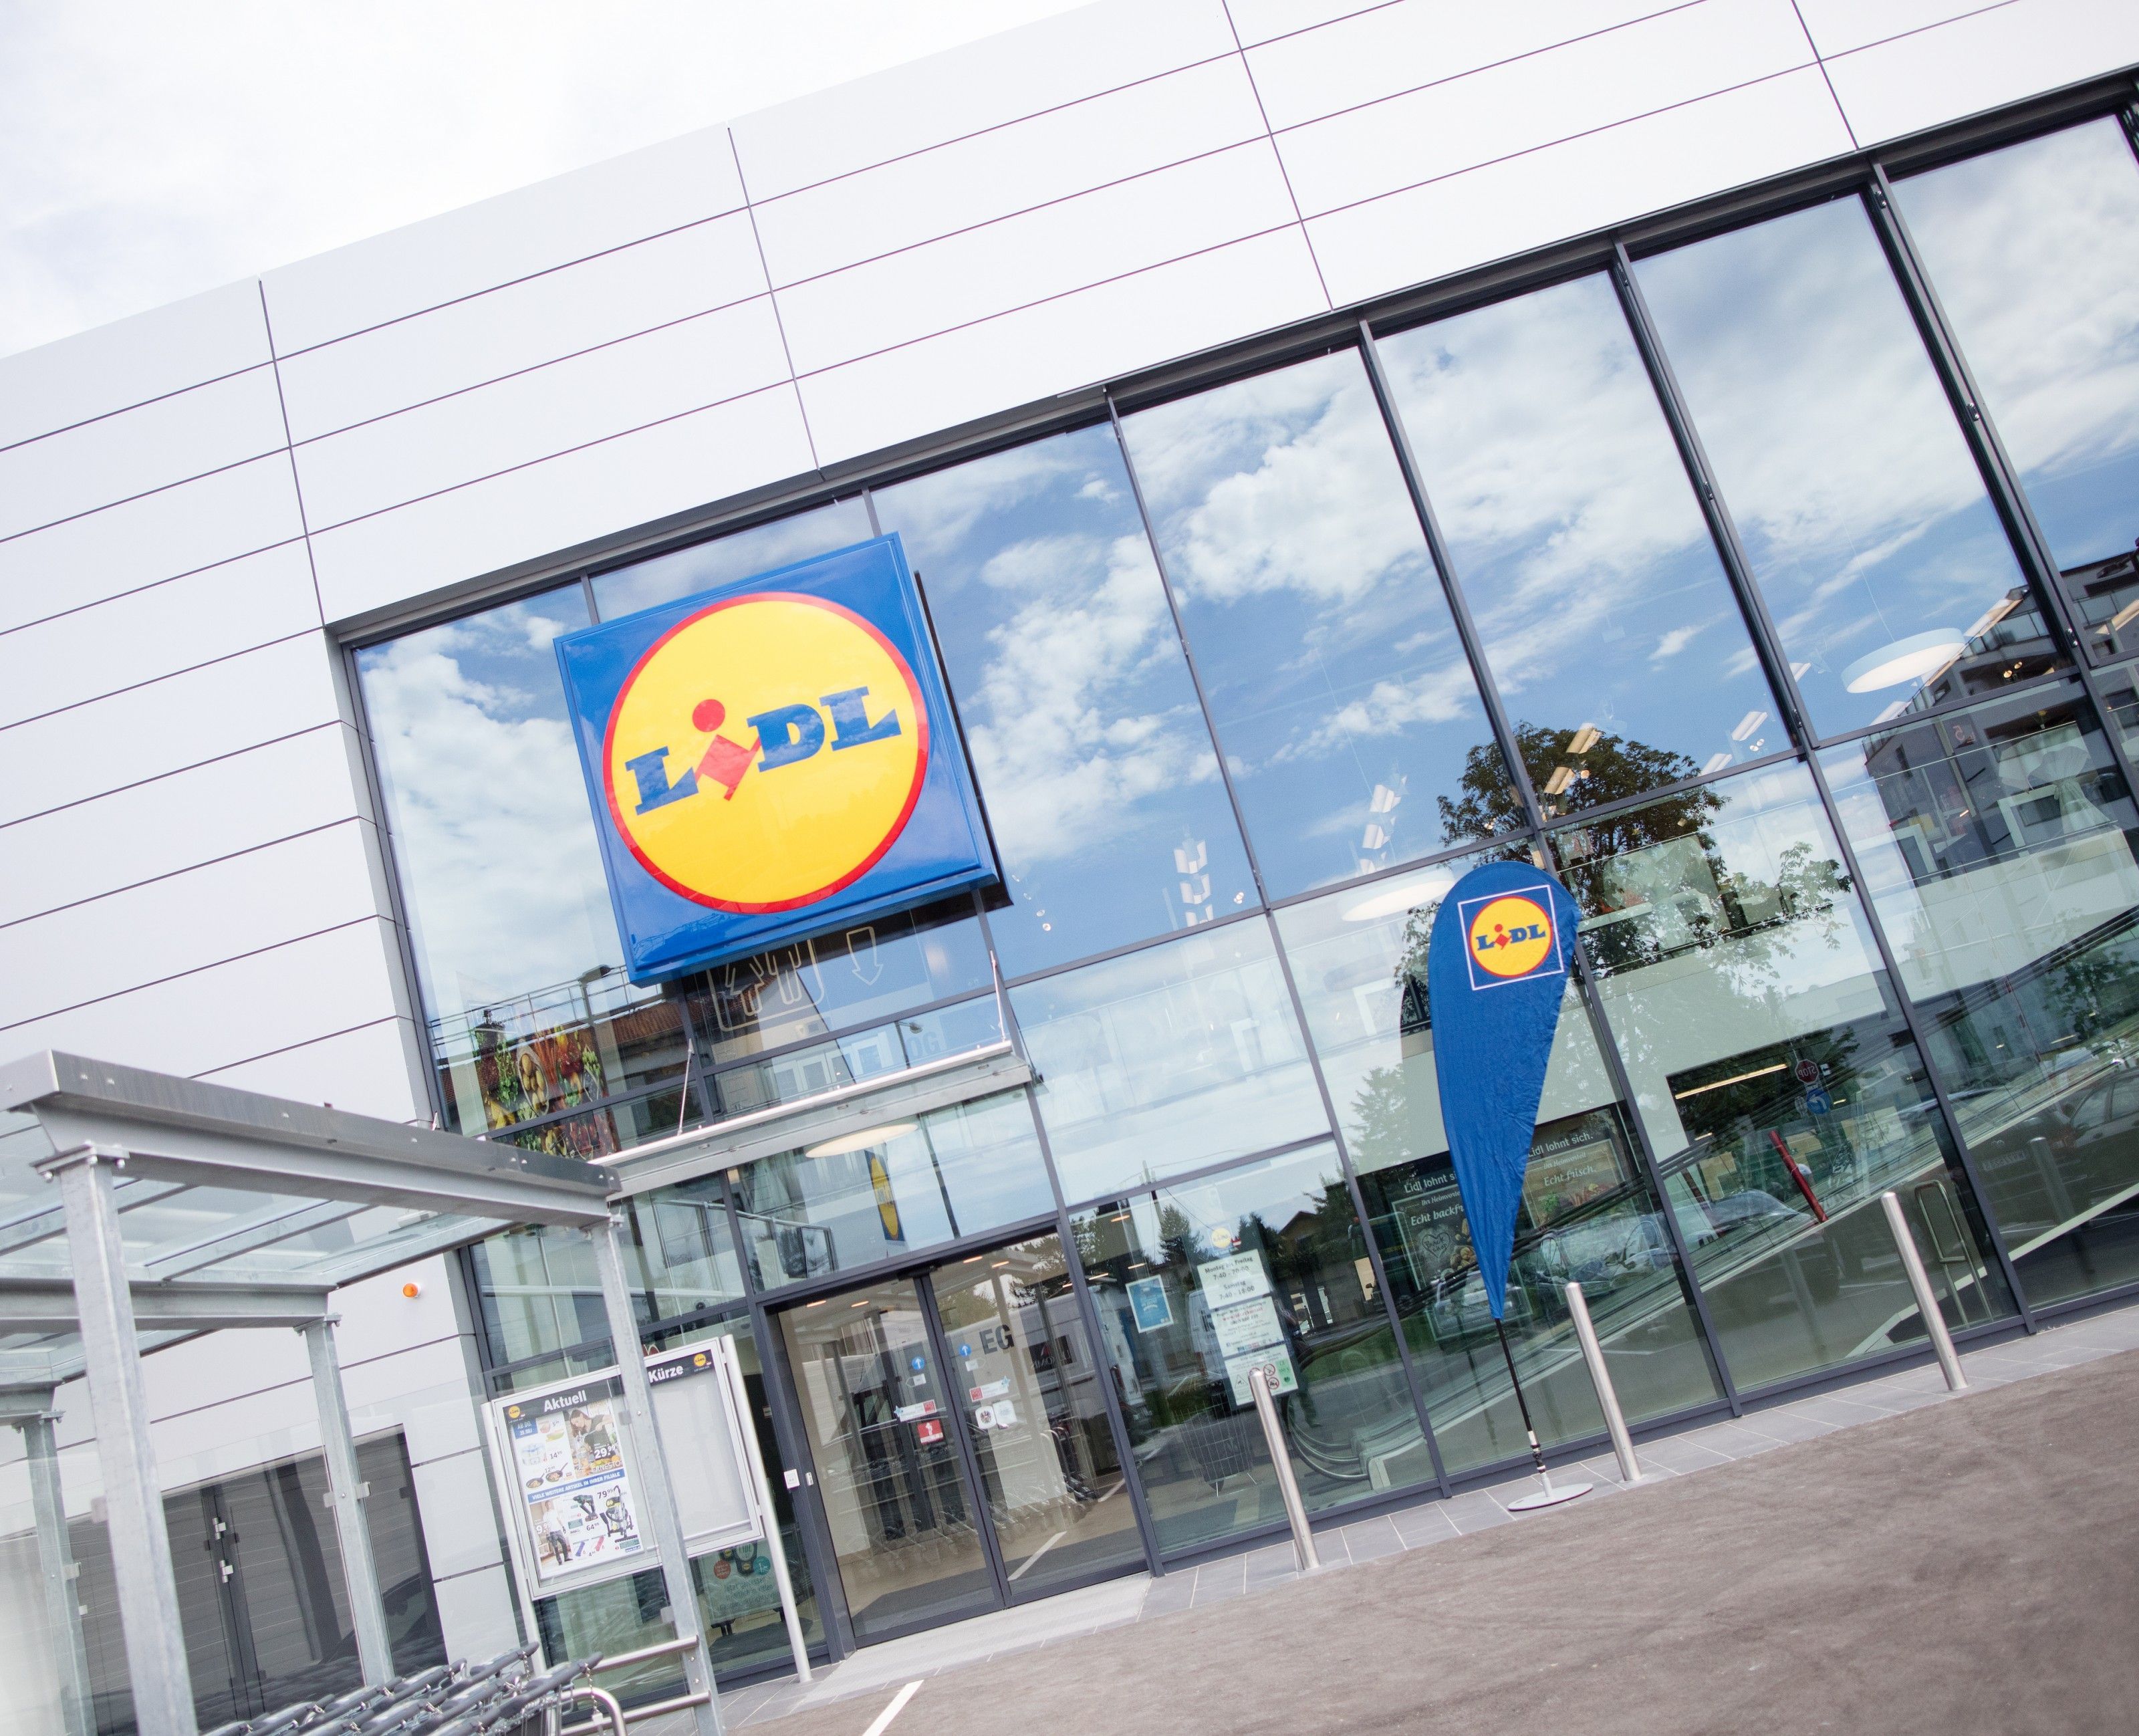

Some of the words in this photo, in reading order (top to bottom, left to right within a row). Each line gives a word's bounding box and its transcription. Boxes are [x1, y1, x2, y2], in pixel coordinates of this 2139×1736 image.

[1545, 1138, 1570, 1152] lohnt
[1571, 1132, 1594, 1144] sich.
[1404, 1179, 1423, 1194] Lidl
[1423, 1174, 1449, 1188] lohnt
[1543, 1174, 1564, 1187] Echt
[1410, 1213, 1431, 1226] Echt
[1432, 1203, 1465, 1220] backfr
[979, 1324, 1015, 1355] EG
[648, 1365, 684, 1383] Kürze
[544, 1390, 587, 1412] Aktuell
